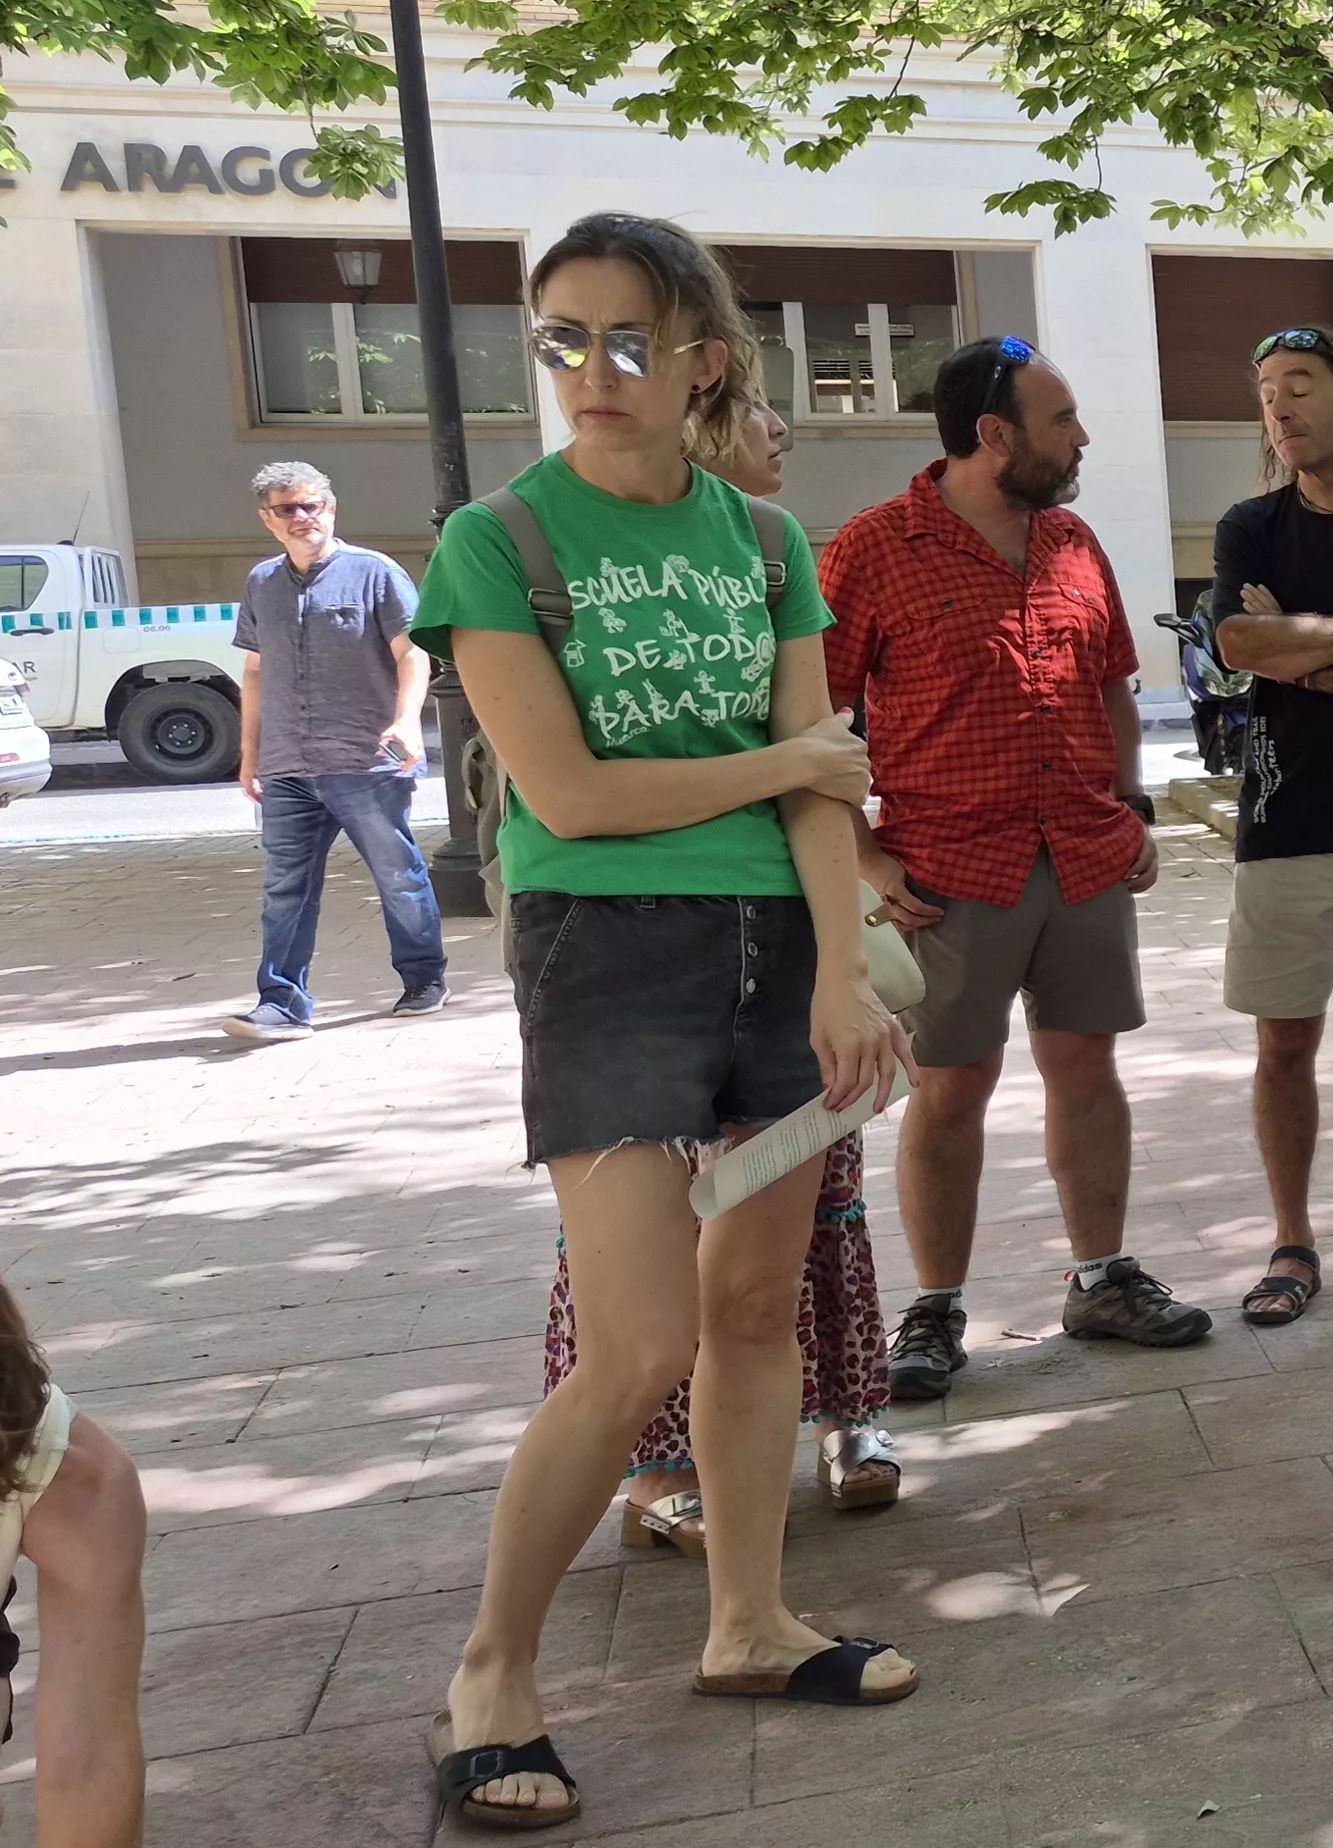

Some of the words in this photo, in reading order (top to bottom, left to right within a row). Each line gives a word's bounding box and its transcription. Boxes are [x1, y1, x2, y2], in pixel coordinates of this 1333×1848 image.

[60, 141, 397, 200] ARAGO
[603, 639, 661, 676] DE
[596, 690, 701, 739] PARA
